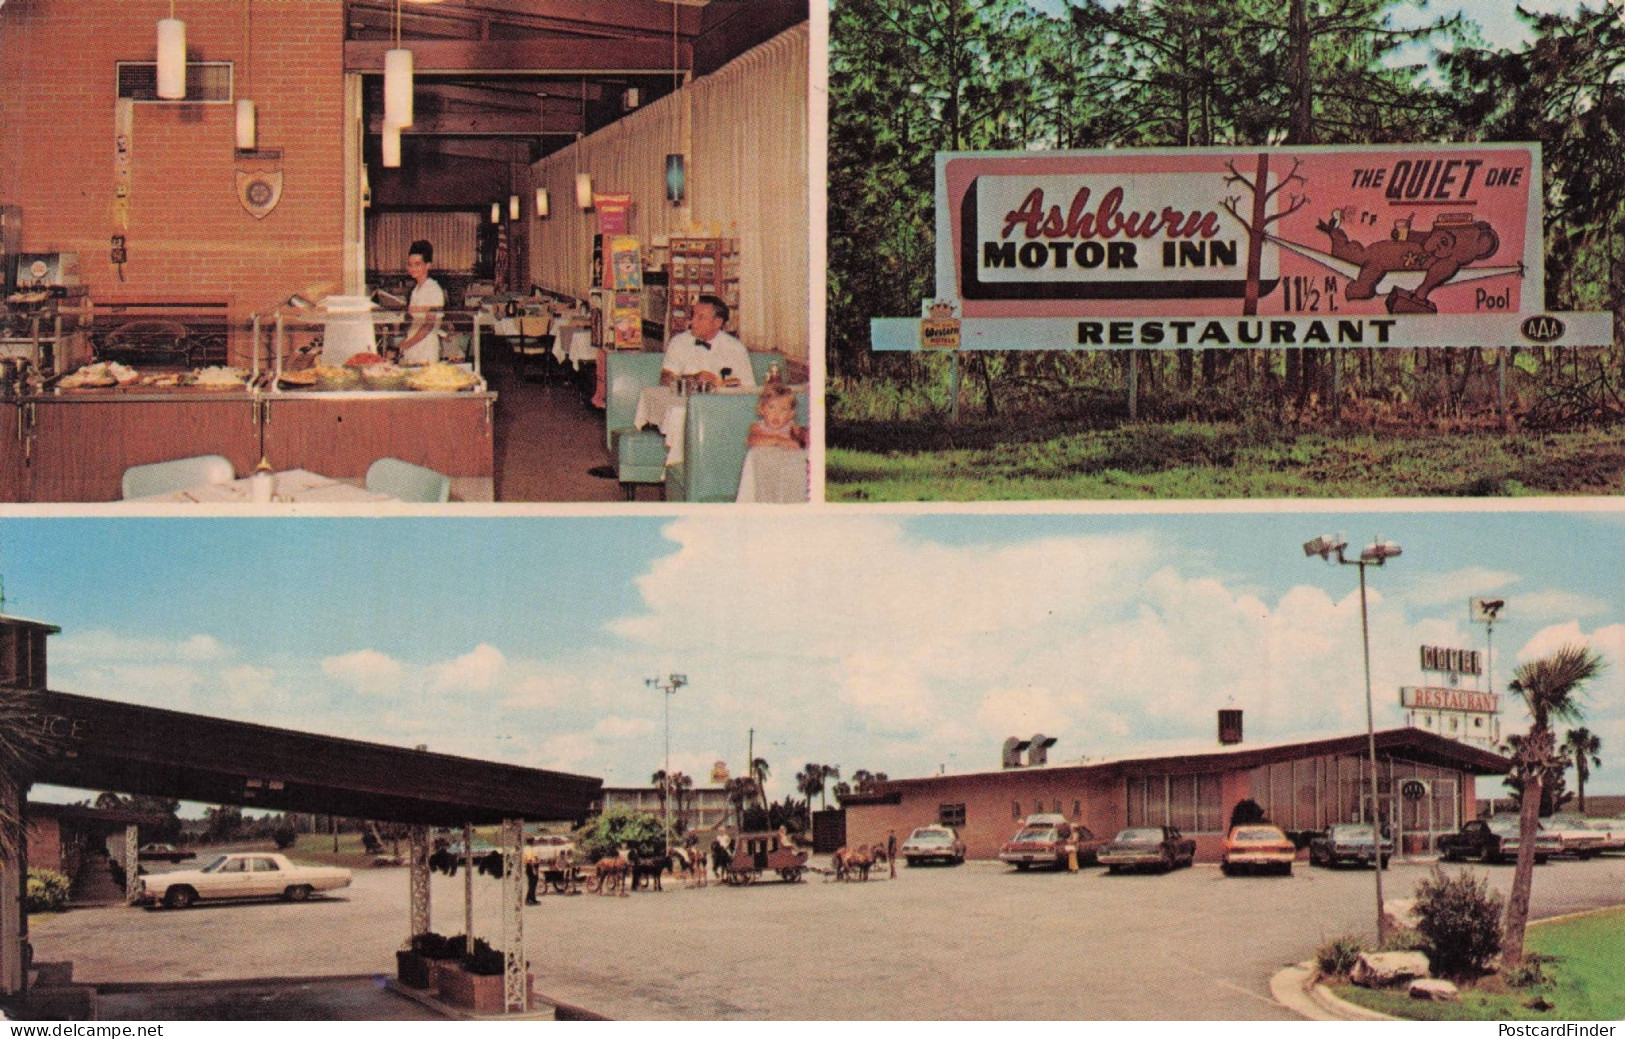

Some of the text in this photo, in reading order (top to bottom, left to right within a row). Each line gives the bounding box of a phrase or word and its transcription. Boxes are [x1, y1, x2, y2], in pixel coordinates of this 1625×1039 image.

[1351, 159, 1524, 200] THE QUIET ONE
[1001, 186, 1221, 239] Ashburn
[983, 240, 1237, 269] MOTOR INN
[1475, 286, 1510, 310] Pool
[1076, 320, 1397, 344] RESTAURANT
[1527, 317, 1559, 338] AAA
[1414, 687, 1499, 712] RESTAURANT
